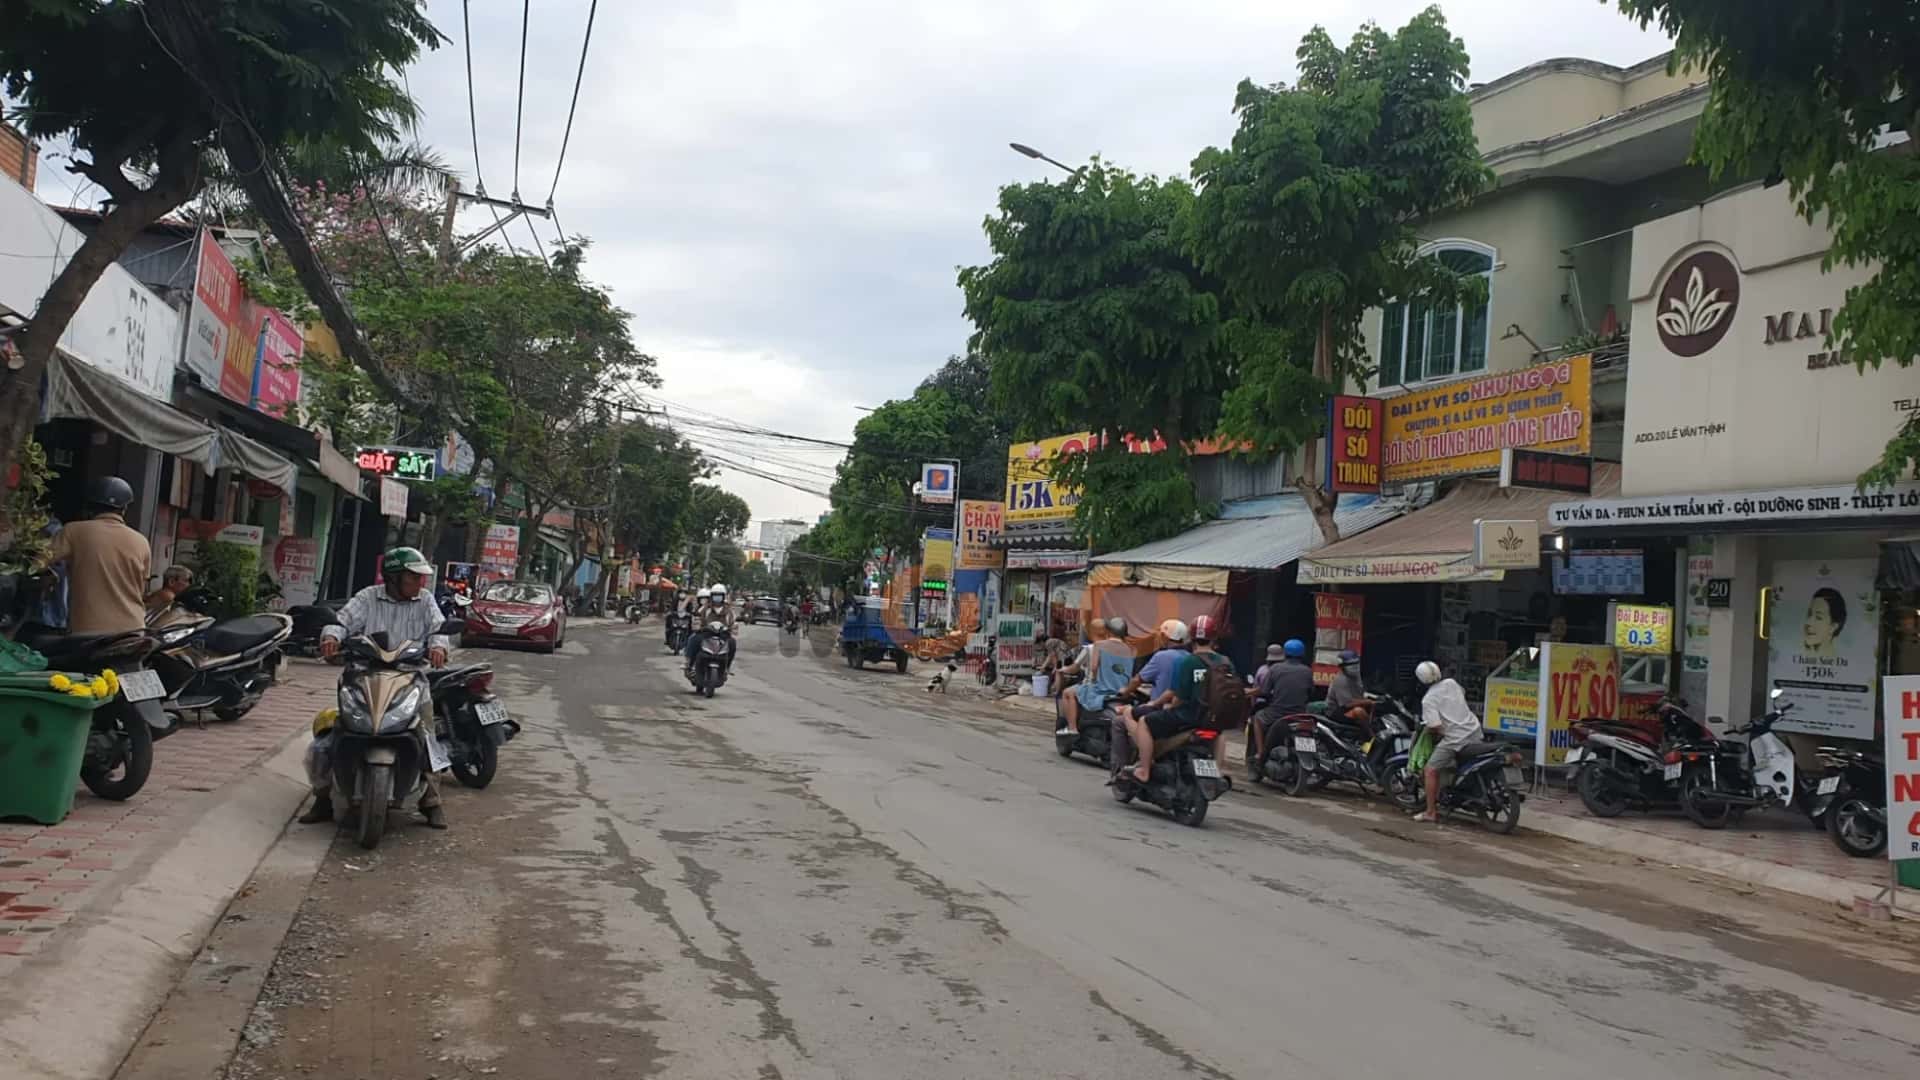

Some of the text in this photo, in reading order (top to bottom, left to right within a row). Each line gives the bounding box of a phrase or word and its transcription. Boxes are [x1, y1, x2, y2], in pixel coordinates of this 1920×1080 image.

[1763, 308, 1832, 345] MAI
[1467, 424, 1497, 454] HOA
[1007, 481, 1054, 511] 15K
[963, 511, 1002, 527] CHAY
[1555, 508, 1570, 521] TƯ
[1572, 504, 1592, 520] VẤN
[1595, 508, 1611, 519] DA
[1617, 506, 1646, 518] PHUN
[1647, 502, 1672, 517] XĂM
[1733, 498, 1756, 516] GỘI
[1758, 497, 1804, 513] DƯỠNG
[1807, 497, 1841, 511] SINH
[1710, 582, 1729, 598] 20
[1628, 628, 1654, 646] 0,3
